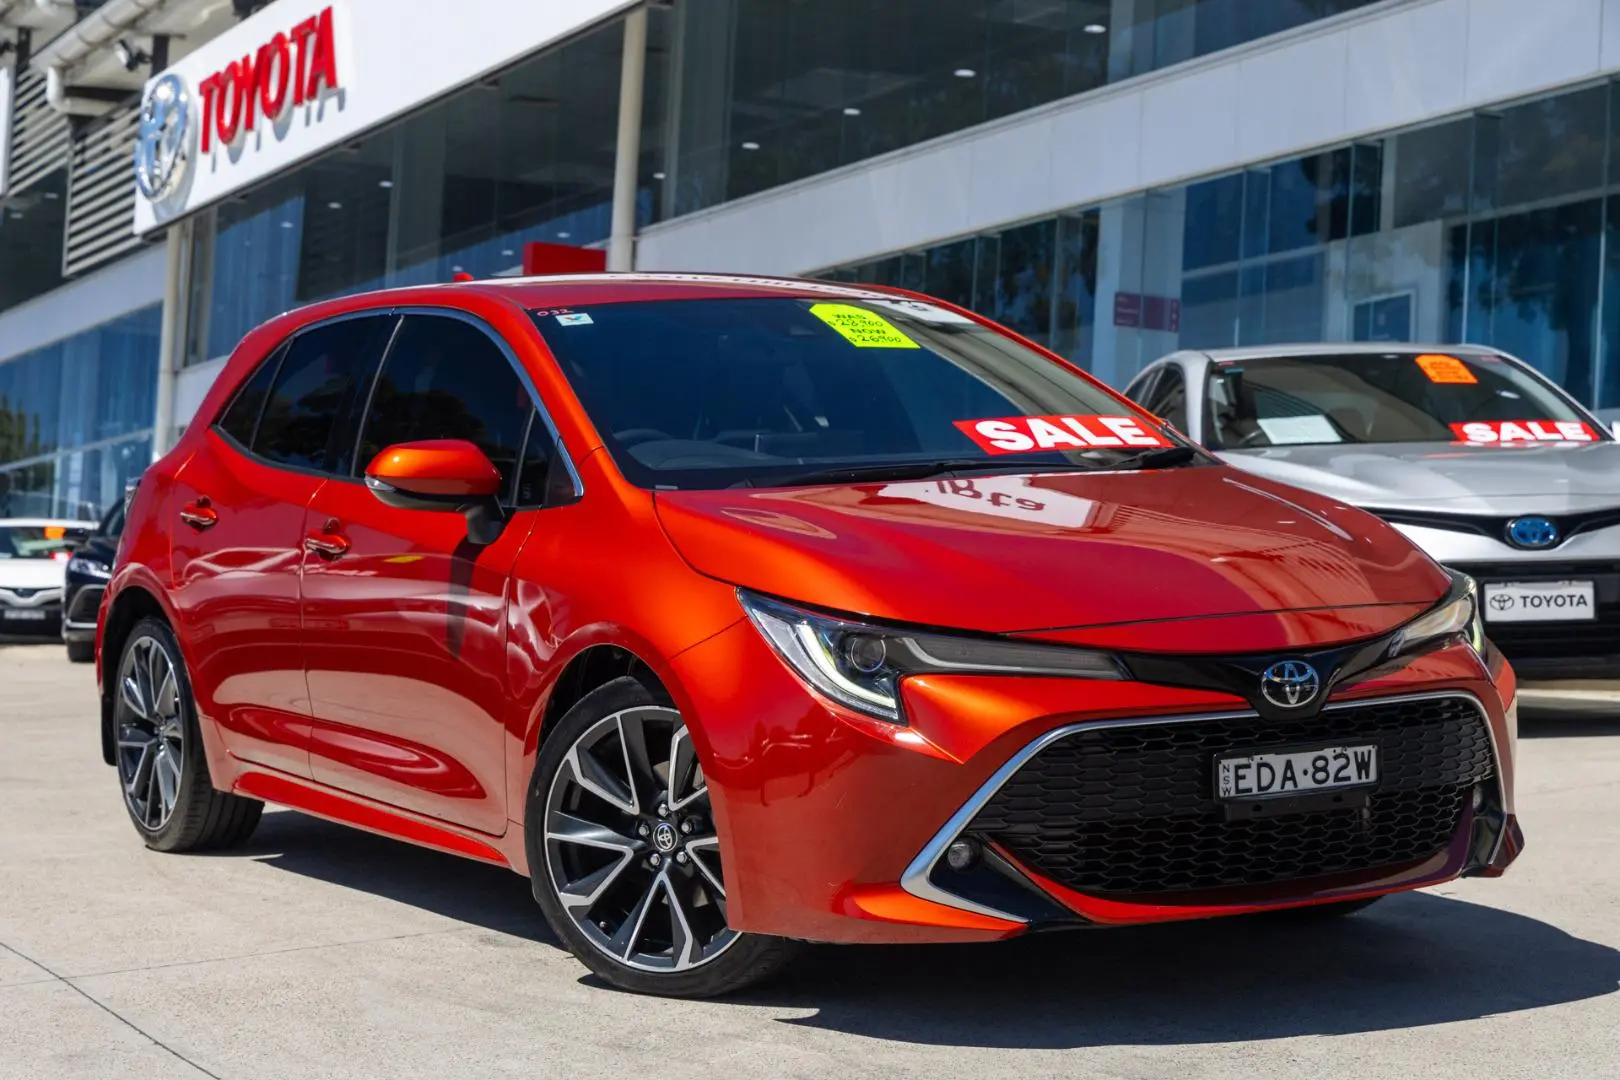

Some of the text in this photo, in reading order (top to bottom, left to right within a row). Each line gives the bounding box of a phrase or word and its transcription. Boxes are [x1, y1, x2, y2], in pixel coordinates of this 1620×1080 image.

[199, 5, 338, 154] TOYOTA
[975, 417, 1161, 451] SALE
[1462, 422, 1593, 442] SALE
[1520, 594, 1588, 608] TOYOTA
